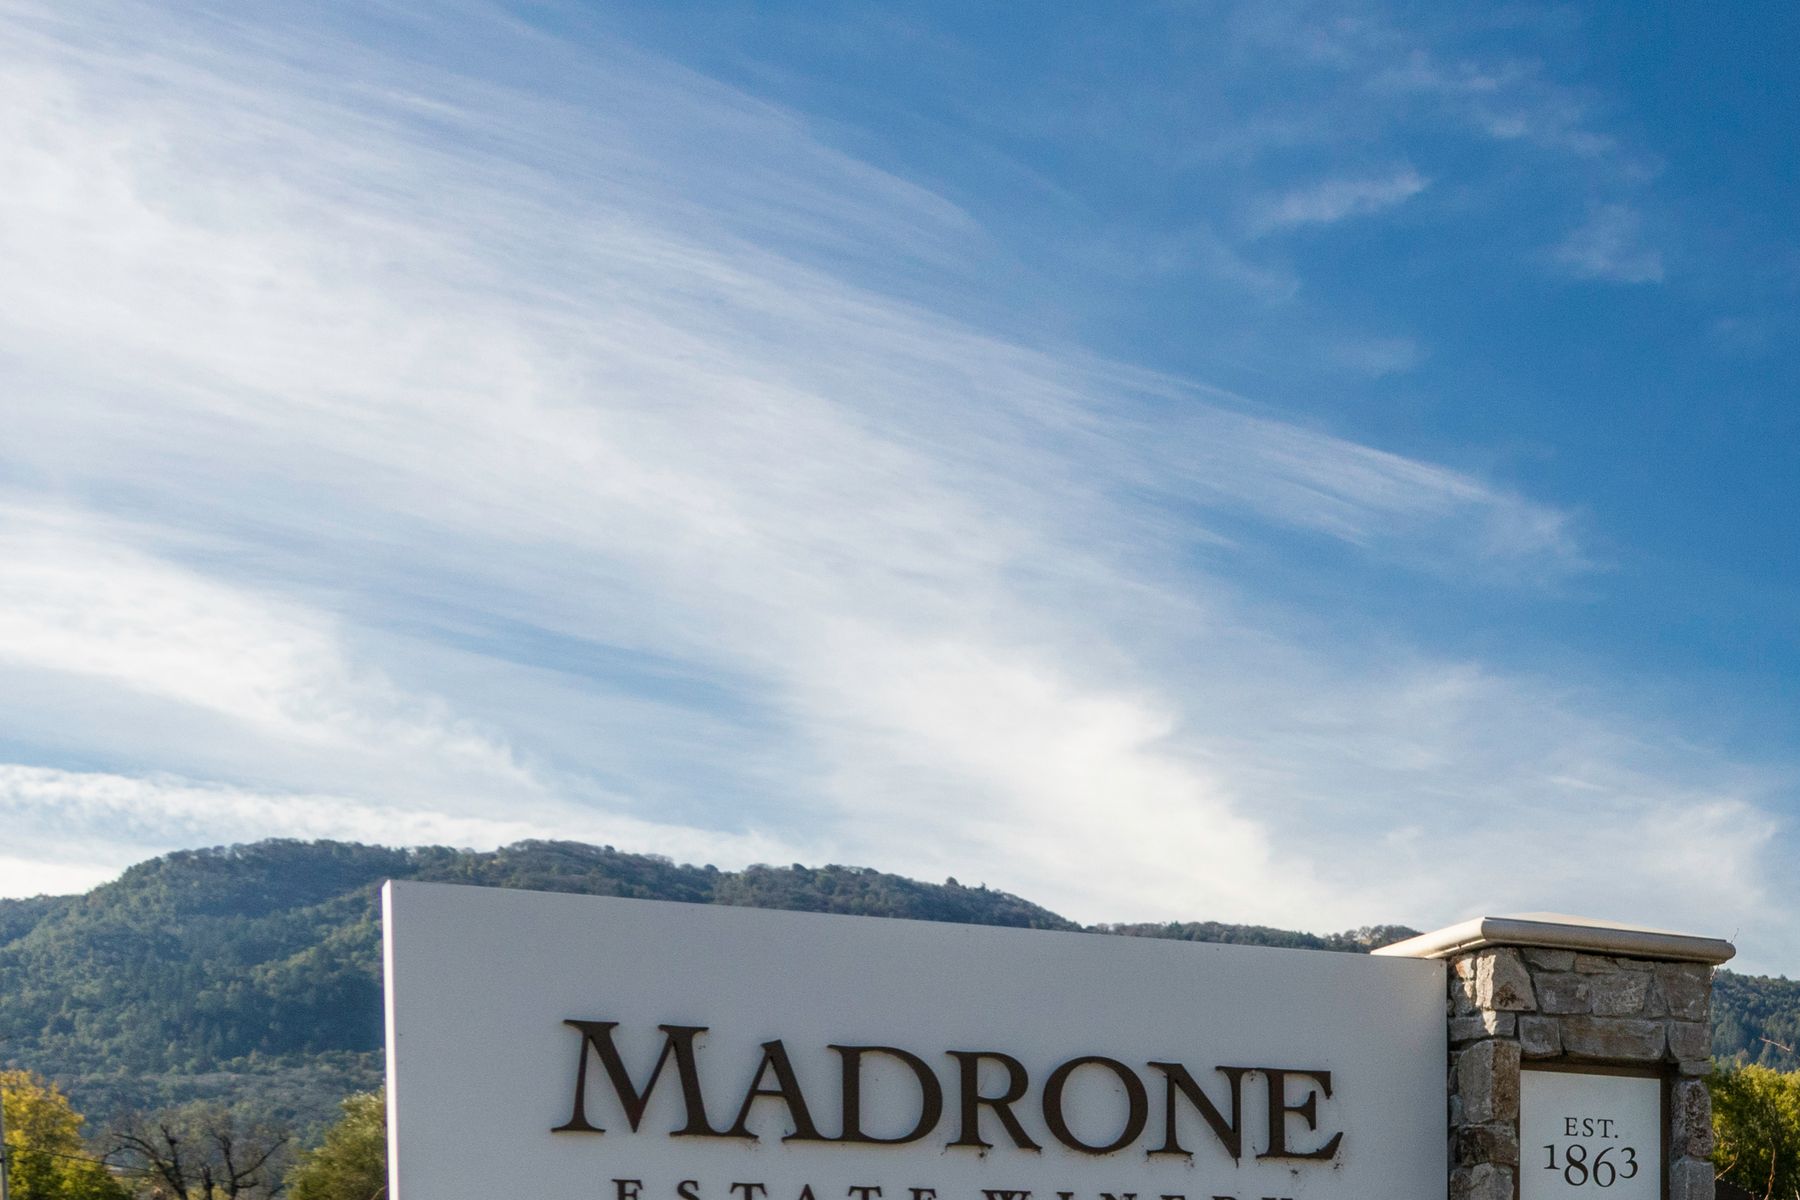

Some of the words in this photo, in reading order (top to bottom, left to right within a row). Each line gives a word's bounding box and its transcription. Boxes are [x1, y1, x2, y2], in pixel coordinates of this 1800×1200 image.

[550, 1019, 1344, 1163] MADRONE
[1563, 1116, 1620, 1139] EST.
[1543, 1143, 1639, 1188] 1863
